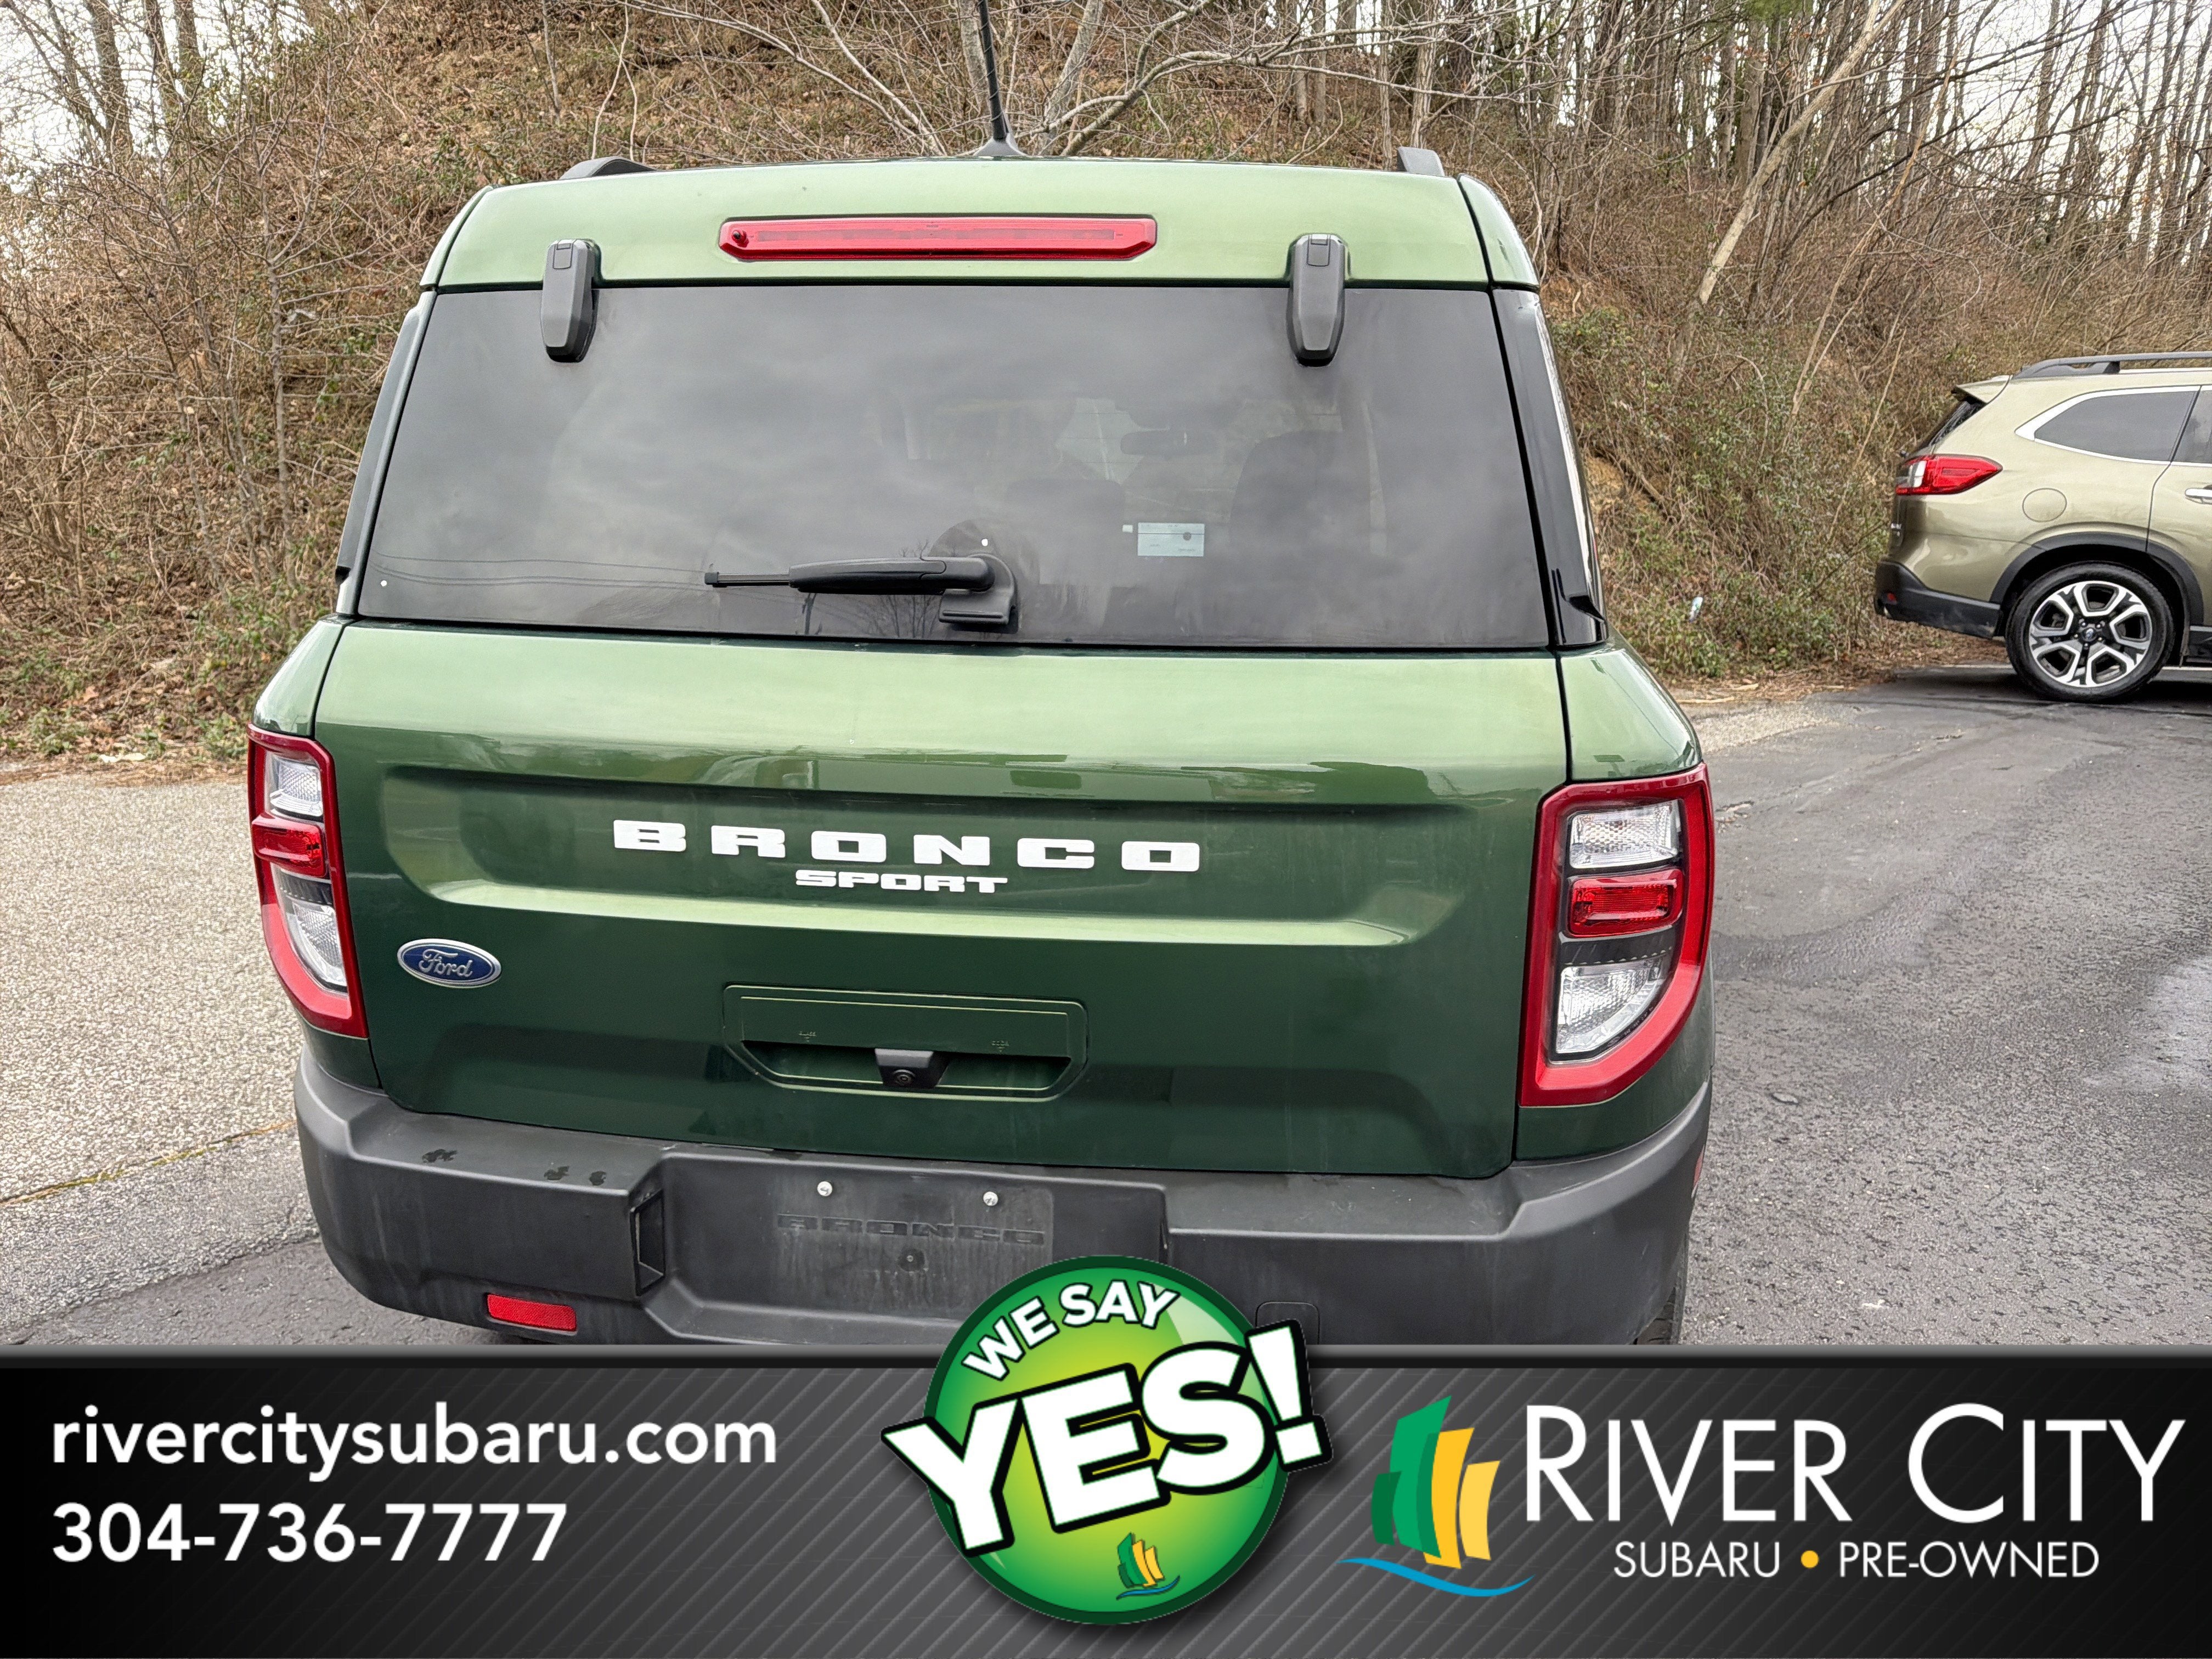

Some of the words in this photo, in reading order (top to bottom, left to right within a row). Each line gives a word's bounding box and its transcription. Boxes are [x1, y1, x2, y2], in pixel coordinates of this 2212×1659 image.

[613, 820, 1200, 872] BRONCO
[795, 870, 1008, 893] SPORT
[418, 948, 473, 978] Ford
[777, 1214, 1045, 1245] BRONCO
